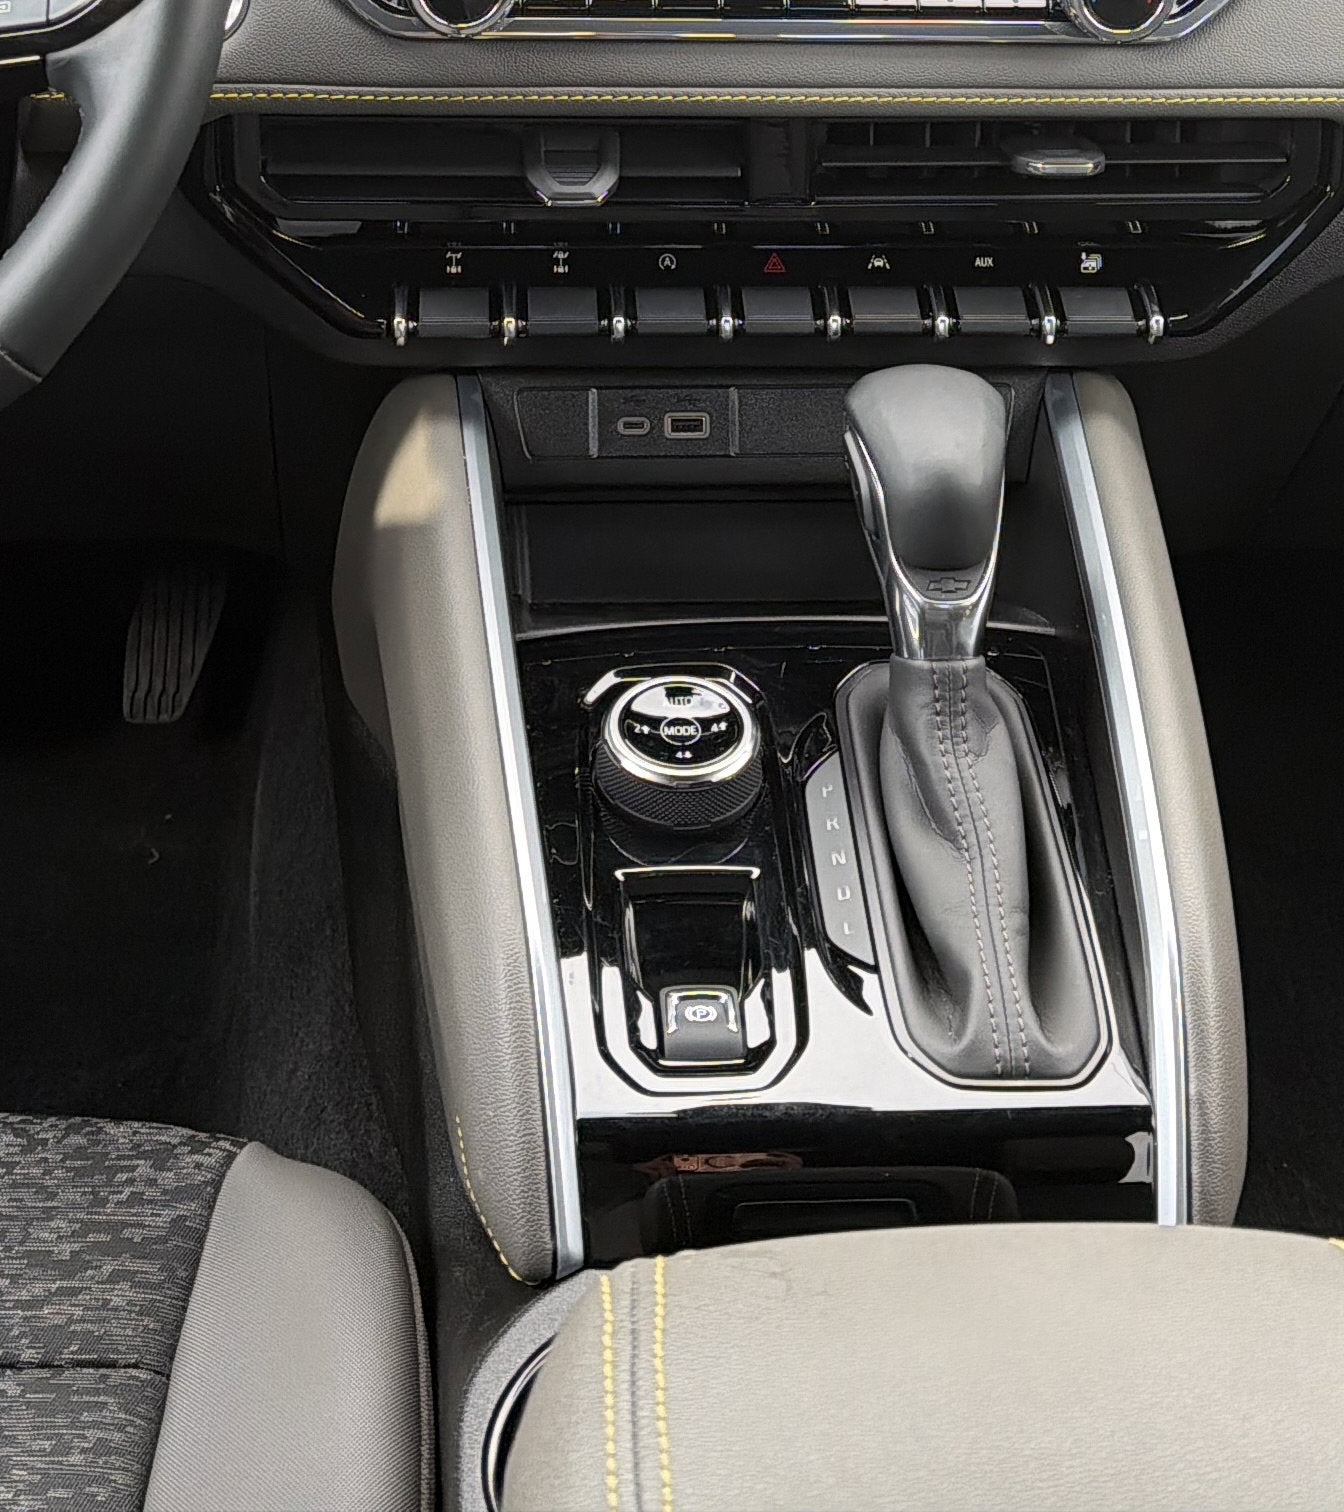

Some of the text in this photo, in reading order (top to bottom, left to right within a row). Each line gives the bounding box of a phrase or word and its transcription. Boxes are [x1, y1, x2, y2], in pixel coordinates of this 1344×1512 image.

[974, 256, 994, 267] AUX
[663, 725, 698, 736] MODE
[831, 850, 847, 866] N
[843, 921, 854, 935] L
